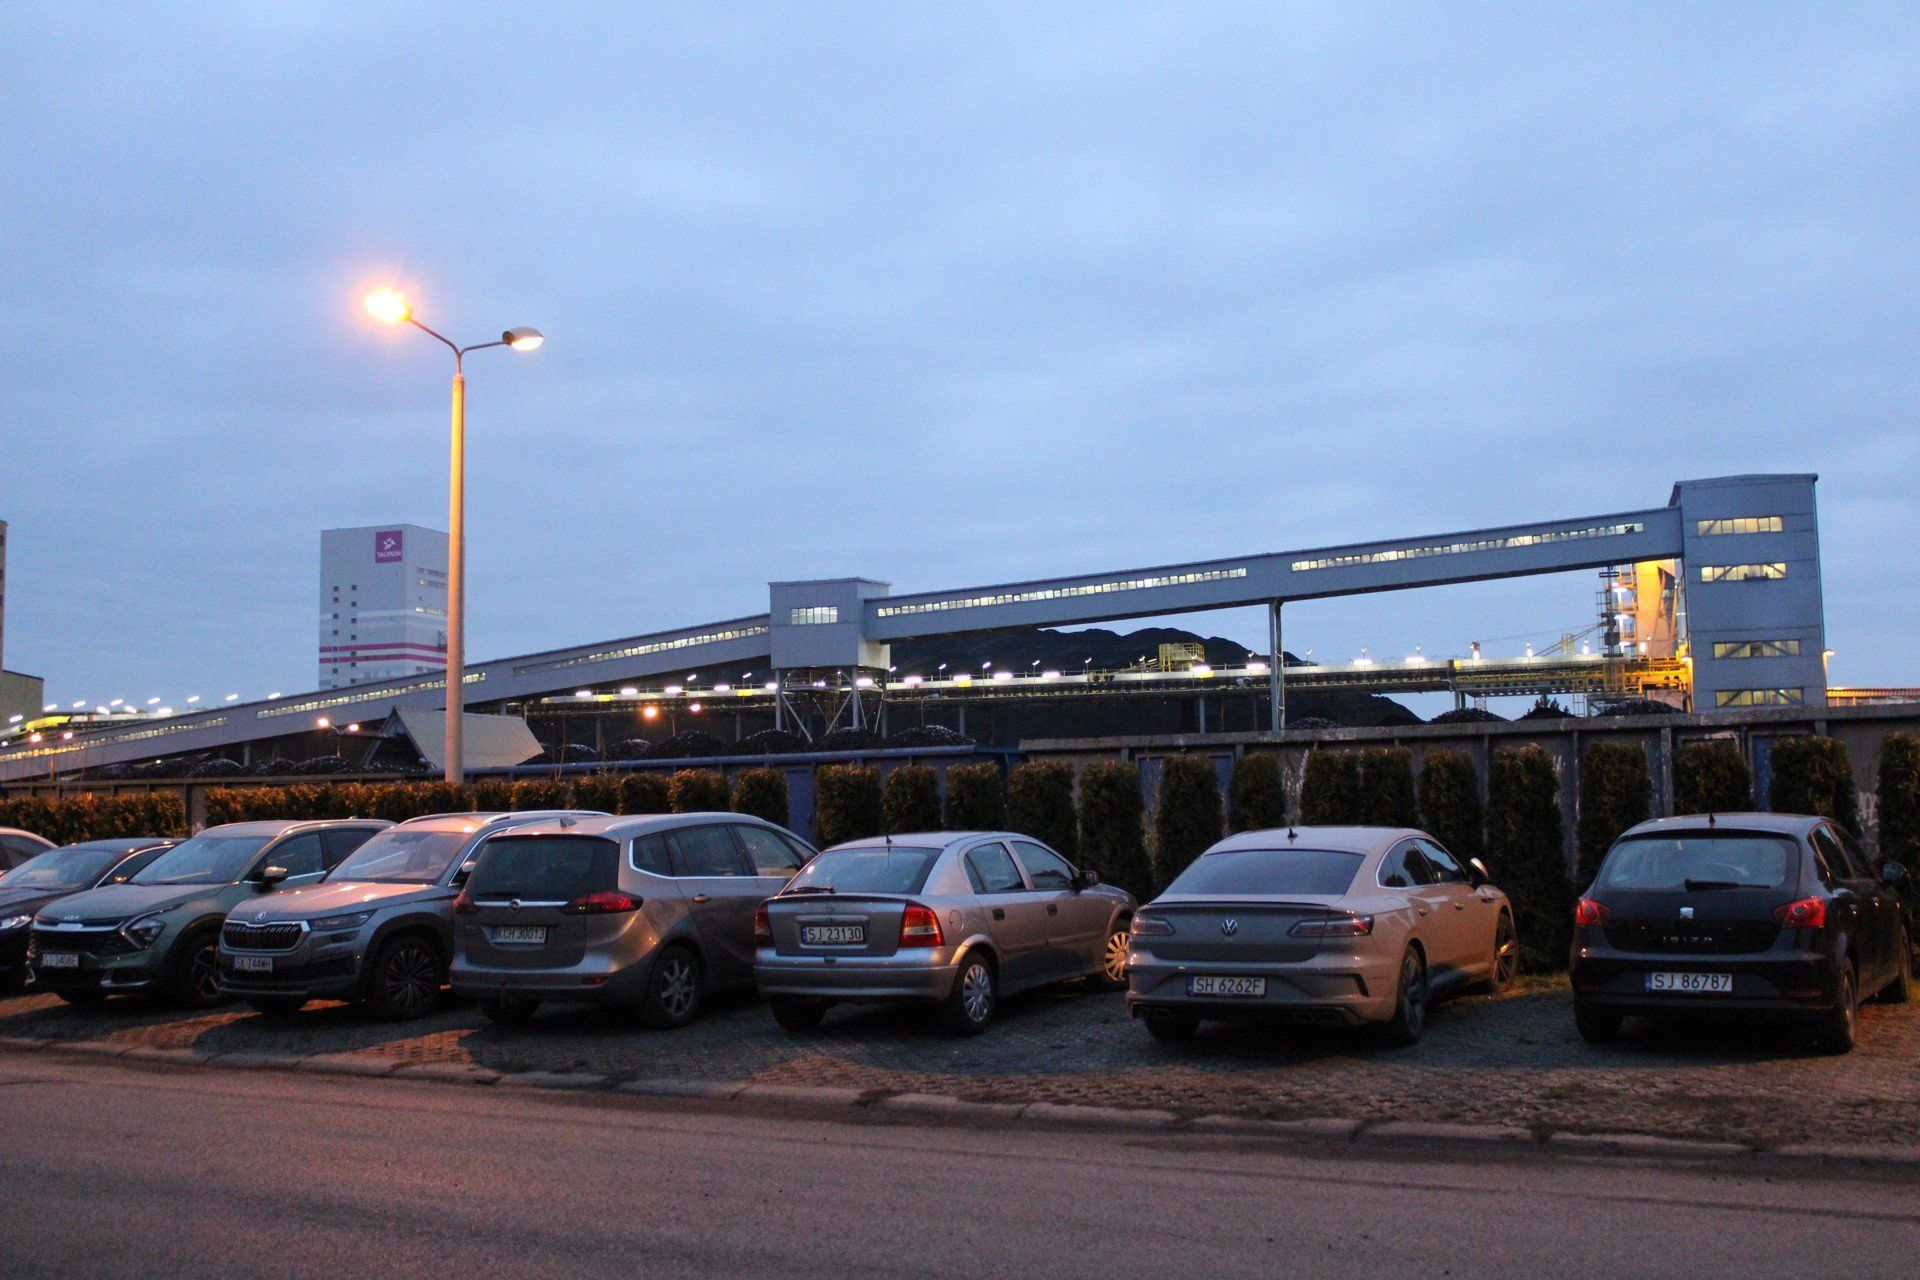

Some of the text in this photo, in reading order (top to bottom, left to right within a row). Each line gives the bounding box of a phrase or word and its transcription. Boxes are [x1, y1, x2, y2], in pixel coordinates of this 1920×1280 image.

[516, 927, 547, 940] 30013
[808, 927, 862, 941] SJ 23130
[1196, 977, 1261, 993] SH 6262F
[1654, 973, 1730, 989] SJ 86787
